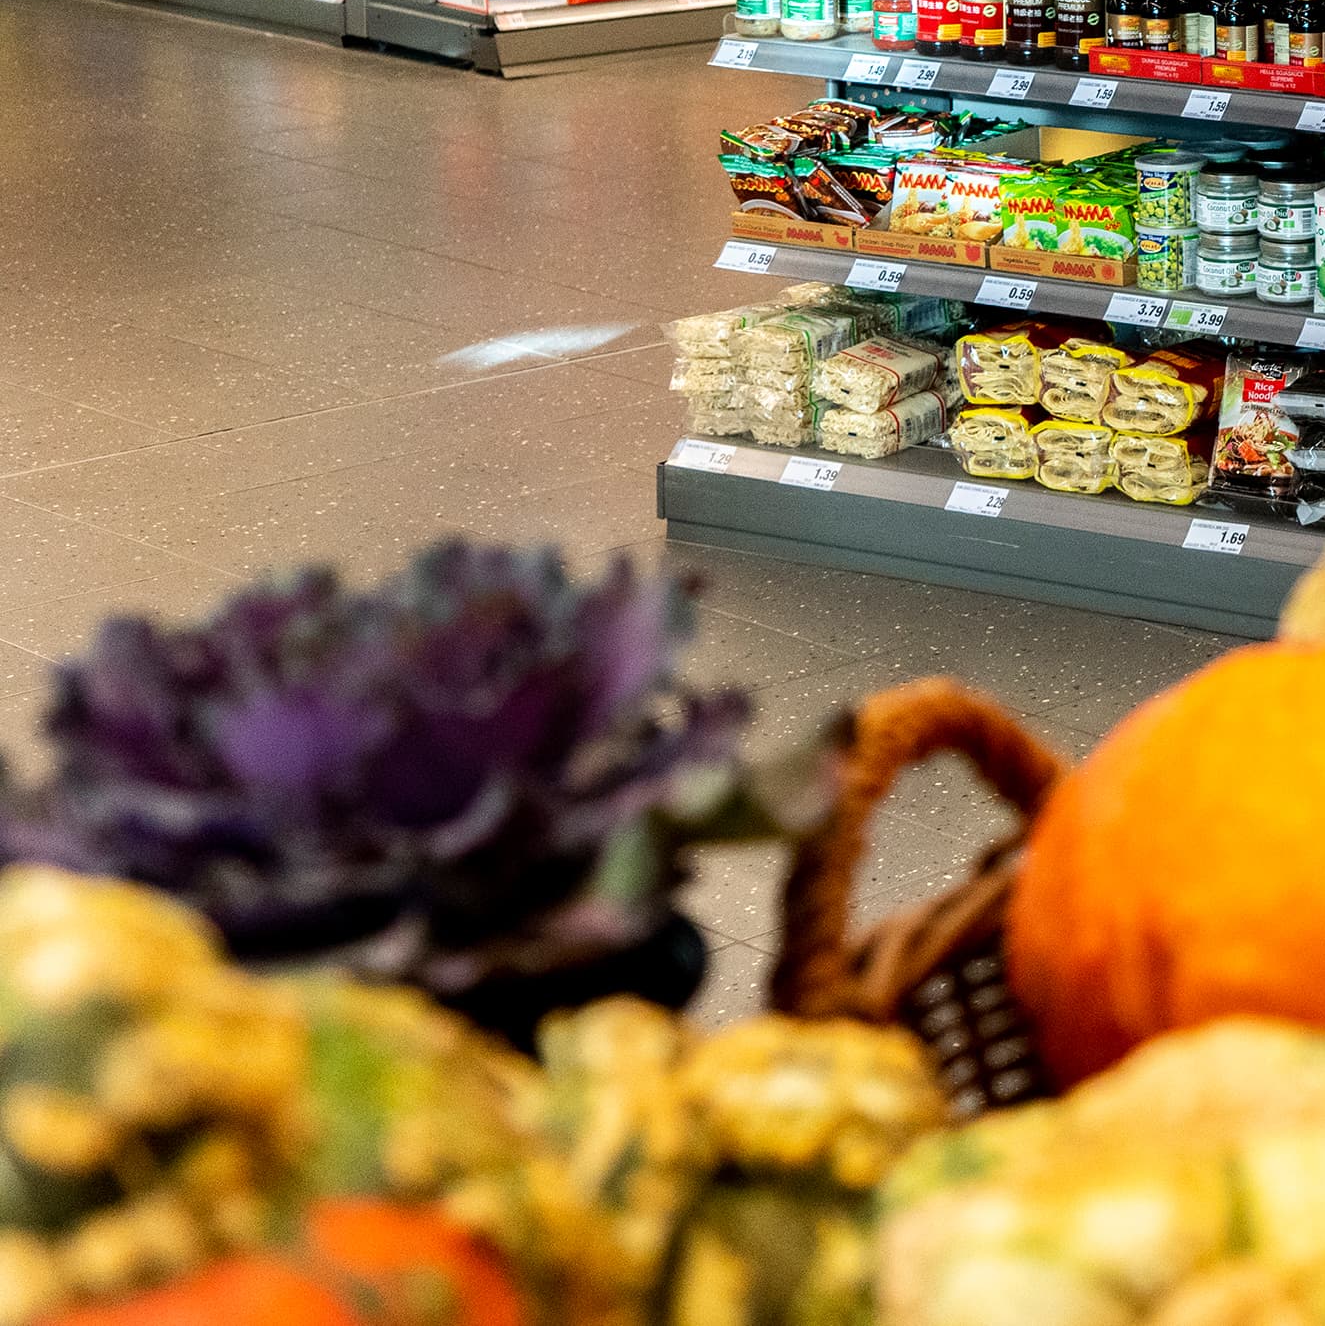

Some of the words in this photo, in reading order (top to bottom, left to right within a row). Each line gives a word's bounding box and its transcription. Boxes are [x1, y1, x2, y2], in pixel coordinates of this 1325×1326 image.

[918, 69, 934, 80] 2.99
[1012, 80, 1029, 91] 2.99
[1096, 88, 1113, 99] 1.59
[1208, 101, 1226, 112] 1.59
[899, 172, 946, 190] MAMA
[951, 182, 999, 199] MAMA
[1008, 197, 1055, 214] MAMA
[1207, 203, 1230, 211] Coconut
[1064, 204, 1113, 221] MAMA
[748, 252, 772, 265] 0.59
[1053, 261, 1096, 278] MAMA
[1203, 265, 1226, 275] Coconut
[878, 270, 901, 283] 0.59
[1009, 287, 1034, 300] 0.59
[1137, 304, 1164, 318] 3.79
[1198, 312, 1224, 326] 3.99
[1255, 383, 1275, 392] Rice
[709, 452, 730, 465] 1.29
[814, 468, 838, 481] 1.39
[986, 496, 1004, 508] 2.29
[1220, 531, 1246, 545] 1.69
